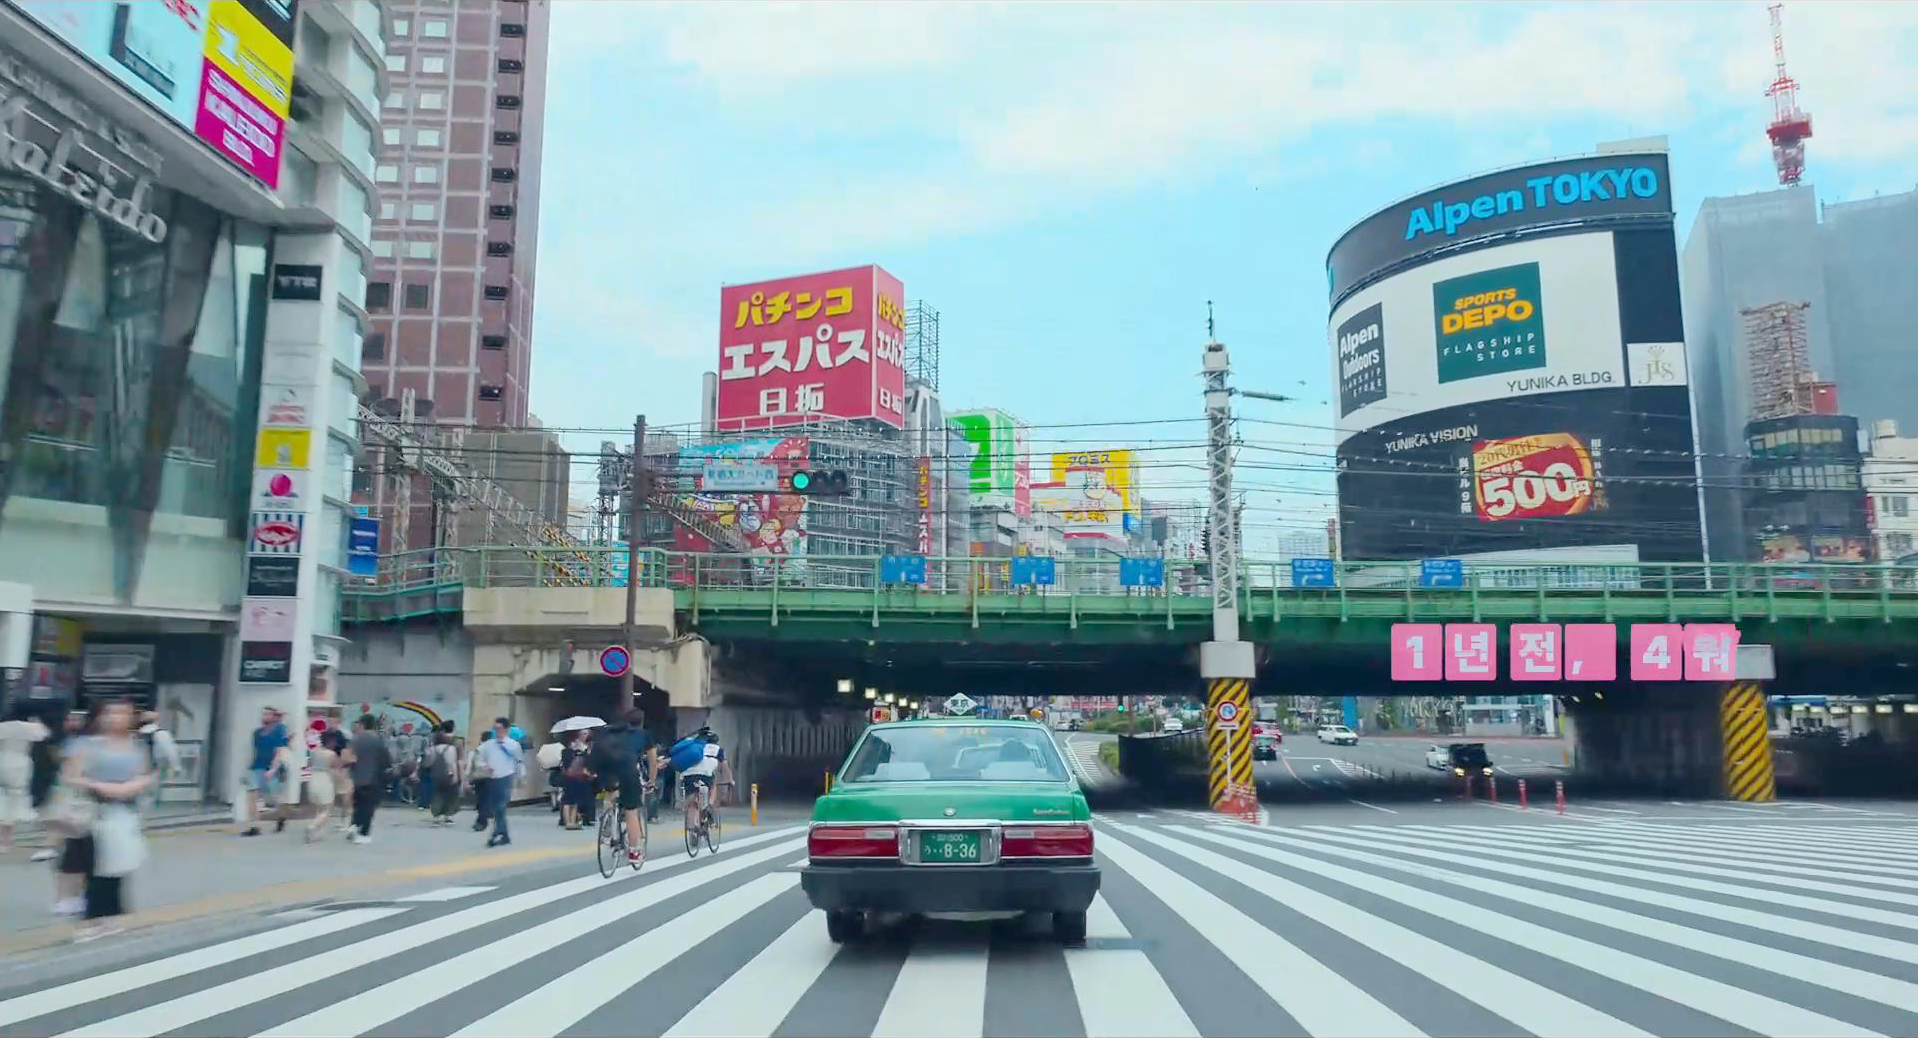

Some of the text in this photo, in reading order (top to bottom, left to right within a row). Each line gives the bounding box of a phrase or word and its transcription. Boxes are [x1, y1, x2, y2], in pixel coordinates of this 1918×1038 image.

[1405, 166, 1658, 241] Alpen TOKYO
[734, 286, 853, 329] パチンコ
[1454, 287, 1517, 310] SPORTS
[1442, 299, 1534, 335] DEPO
[721, 323, 870, 380] エスパス
[1340, 323, 1380, 358] Alpen
[1443, 332, 1535, 356] FLAGSHIP
[1477, 345, 1536, 362] STORE
[1342, 348, 1381, 380] Outdoors
[1507, 374, 1569, 392] YUNIKA
[1385, 424, 1479, 454] YUNIKA VISION
